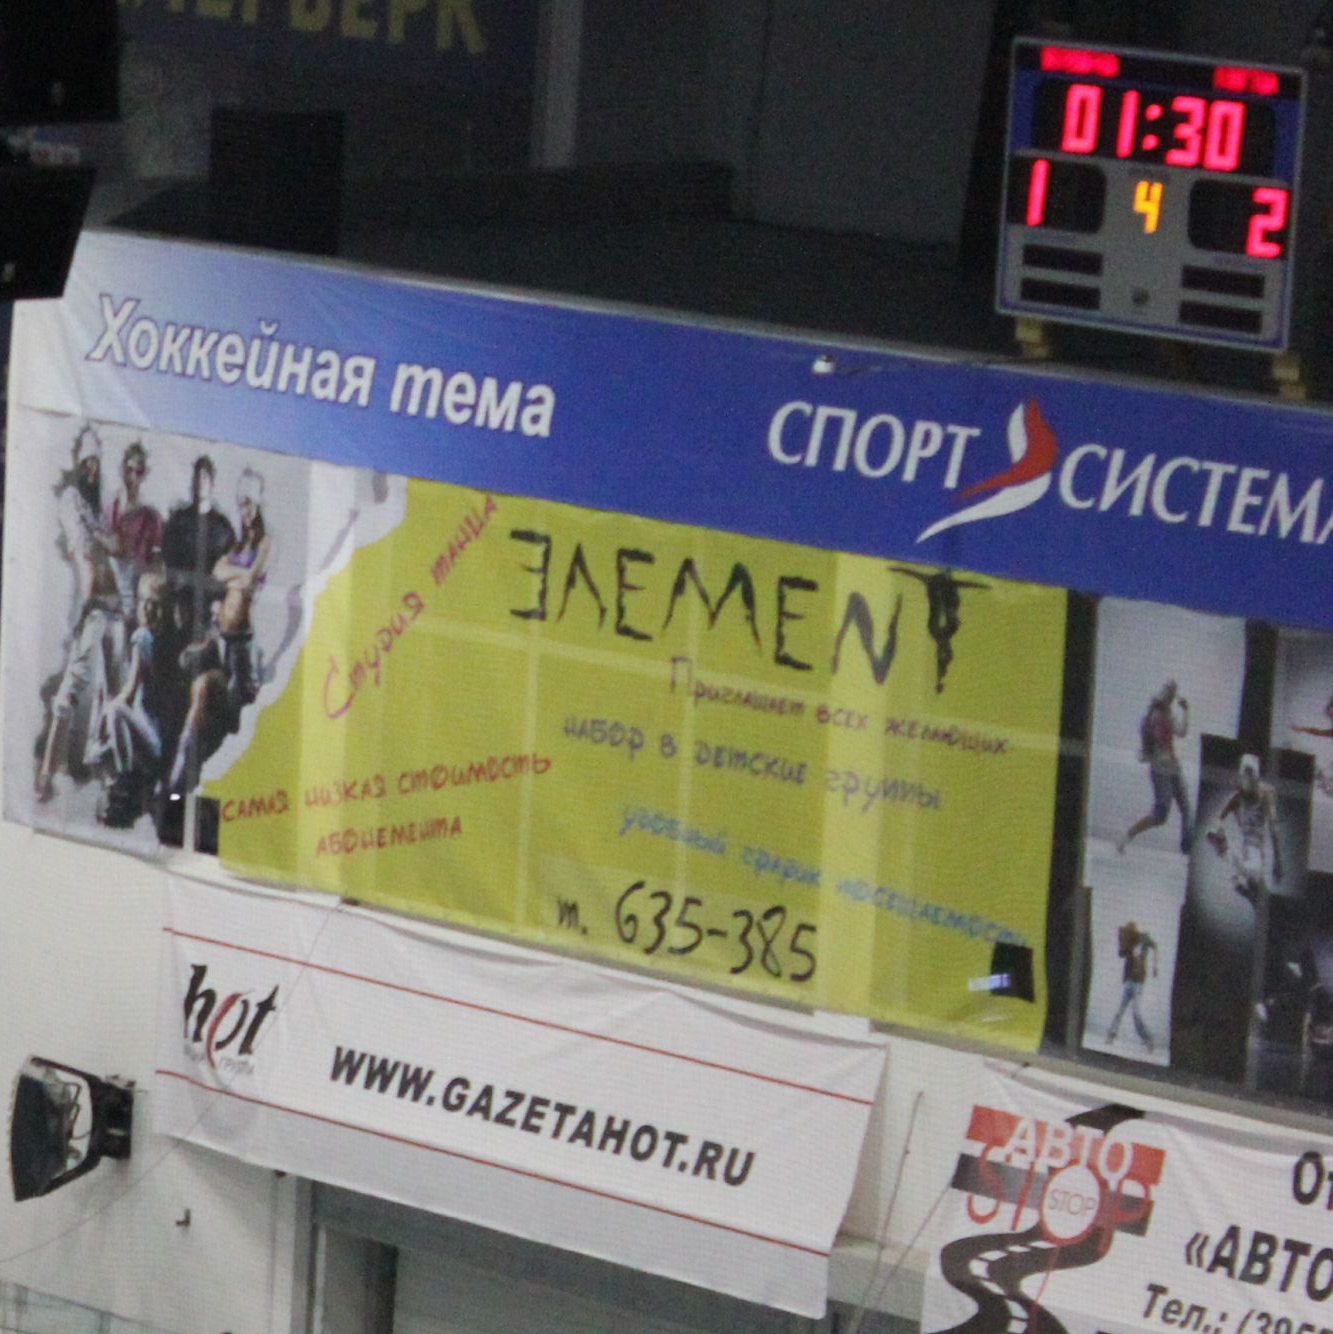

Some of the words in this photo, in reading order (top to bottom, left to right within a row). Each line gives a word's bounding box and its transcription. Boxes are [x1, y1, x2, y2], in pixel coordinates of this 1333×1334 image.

[1061, 83, 1246, 172] 01:30
[1134, 180, 1164, 234] 4
[1246, 187, 1289, 259] 2
[85, 292, 377, 409] Хоккейная
[389, 361, 557, 438] тема
[767, 400, 981, 490] СПОРТ
[614, 880, 818, 984] 635-385
[183, 964, 280, 1064] hot
[330, 1045, 756, 1188] WWW.GAZETAHOT.RU
[1047, 1190, 1096, 1217] STOP
